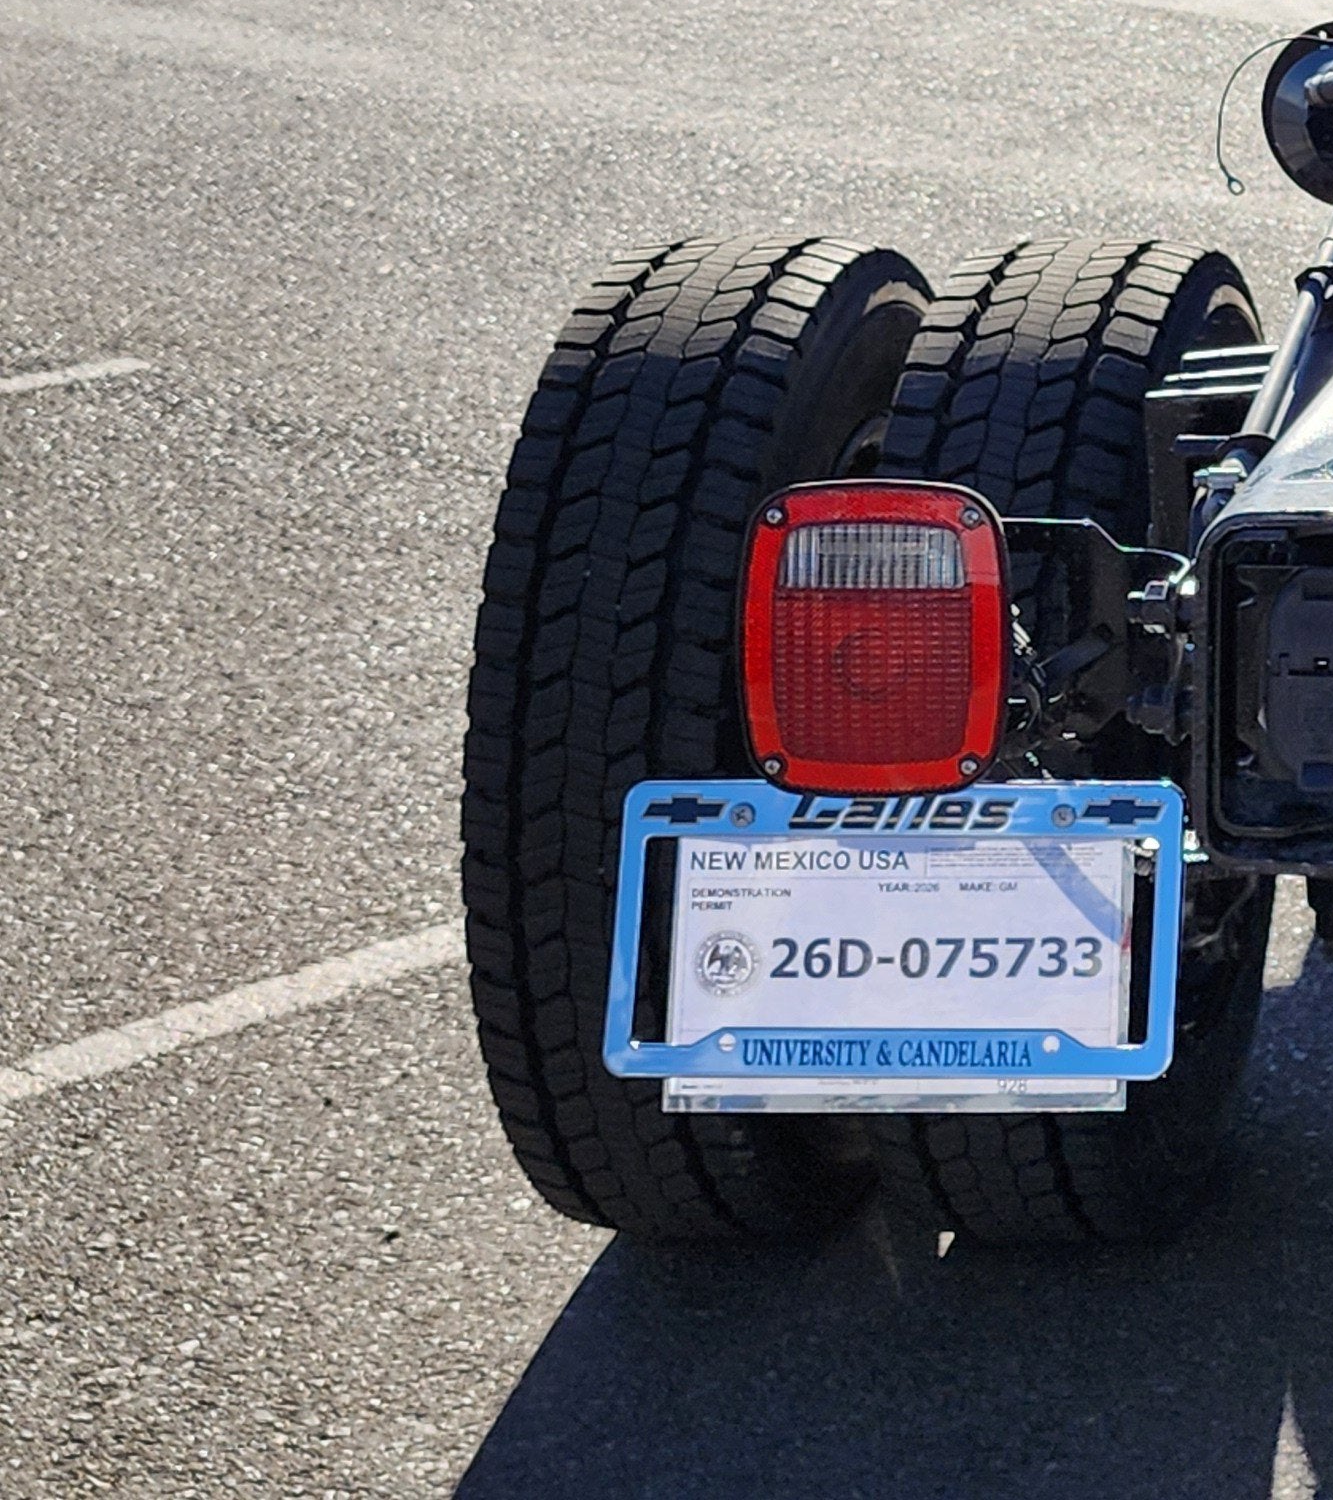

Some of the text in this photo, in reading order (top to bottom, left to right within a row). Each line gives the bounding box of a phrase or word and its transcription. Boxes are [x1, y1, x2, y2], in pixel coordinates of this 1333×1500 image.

[691, 851, 747, 870] NEW
[754, 851, 851, 870] MEXICO
[858, 850, 909, 870] USA
[691, 888, 792, 898] DEMONSTRATION
[691, 901, 733, 911] PERMIT
[769, 937, 1102, 978] 26D-075733
[742, 1039, 1032, 1067] UNIVERSITY & CANDELARIA
